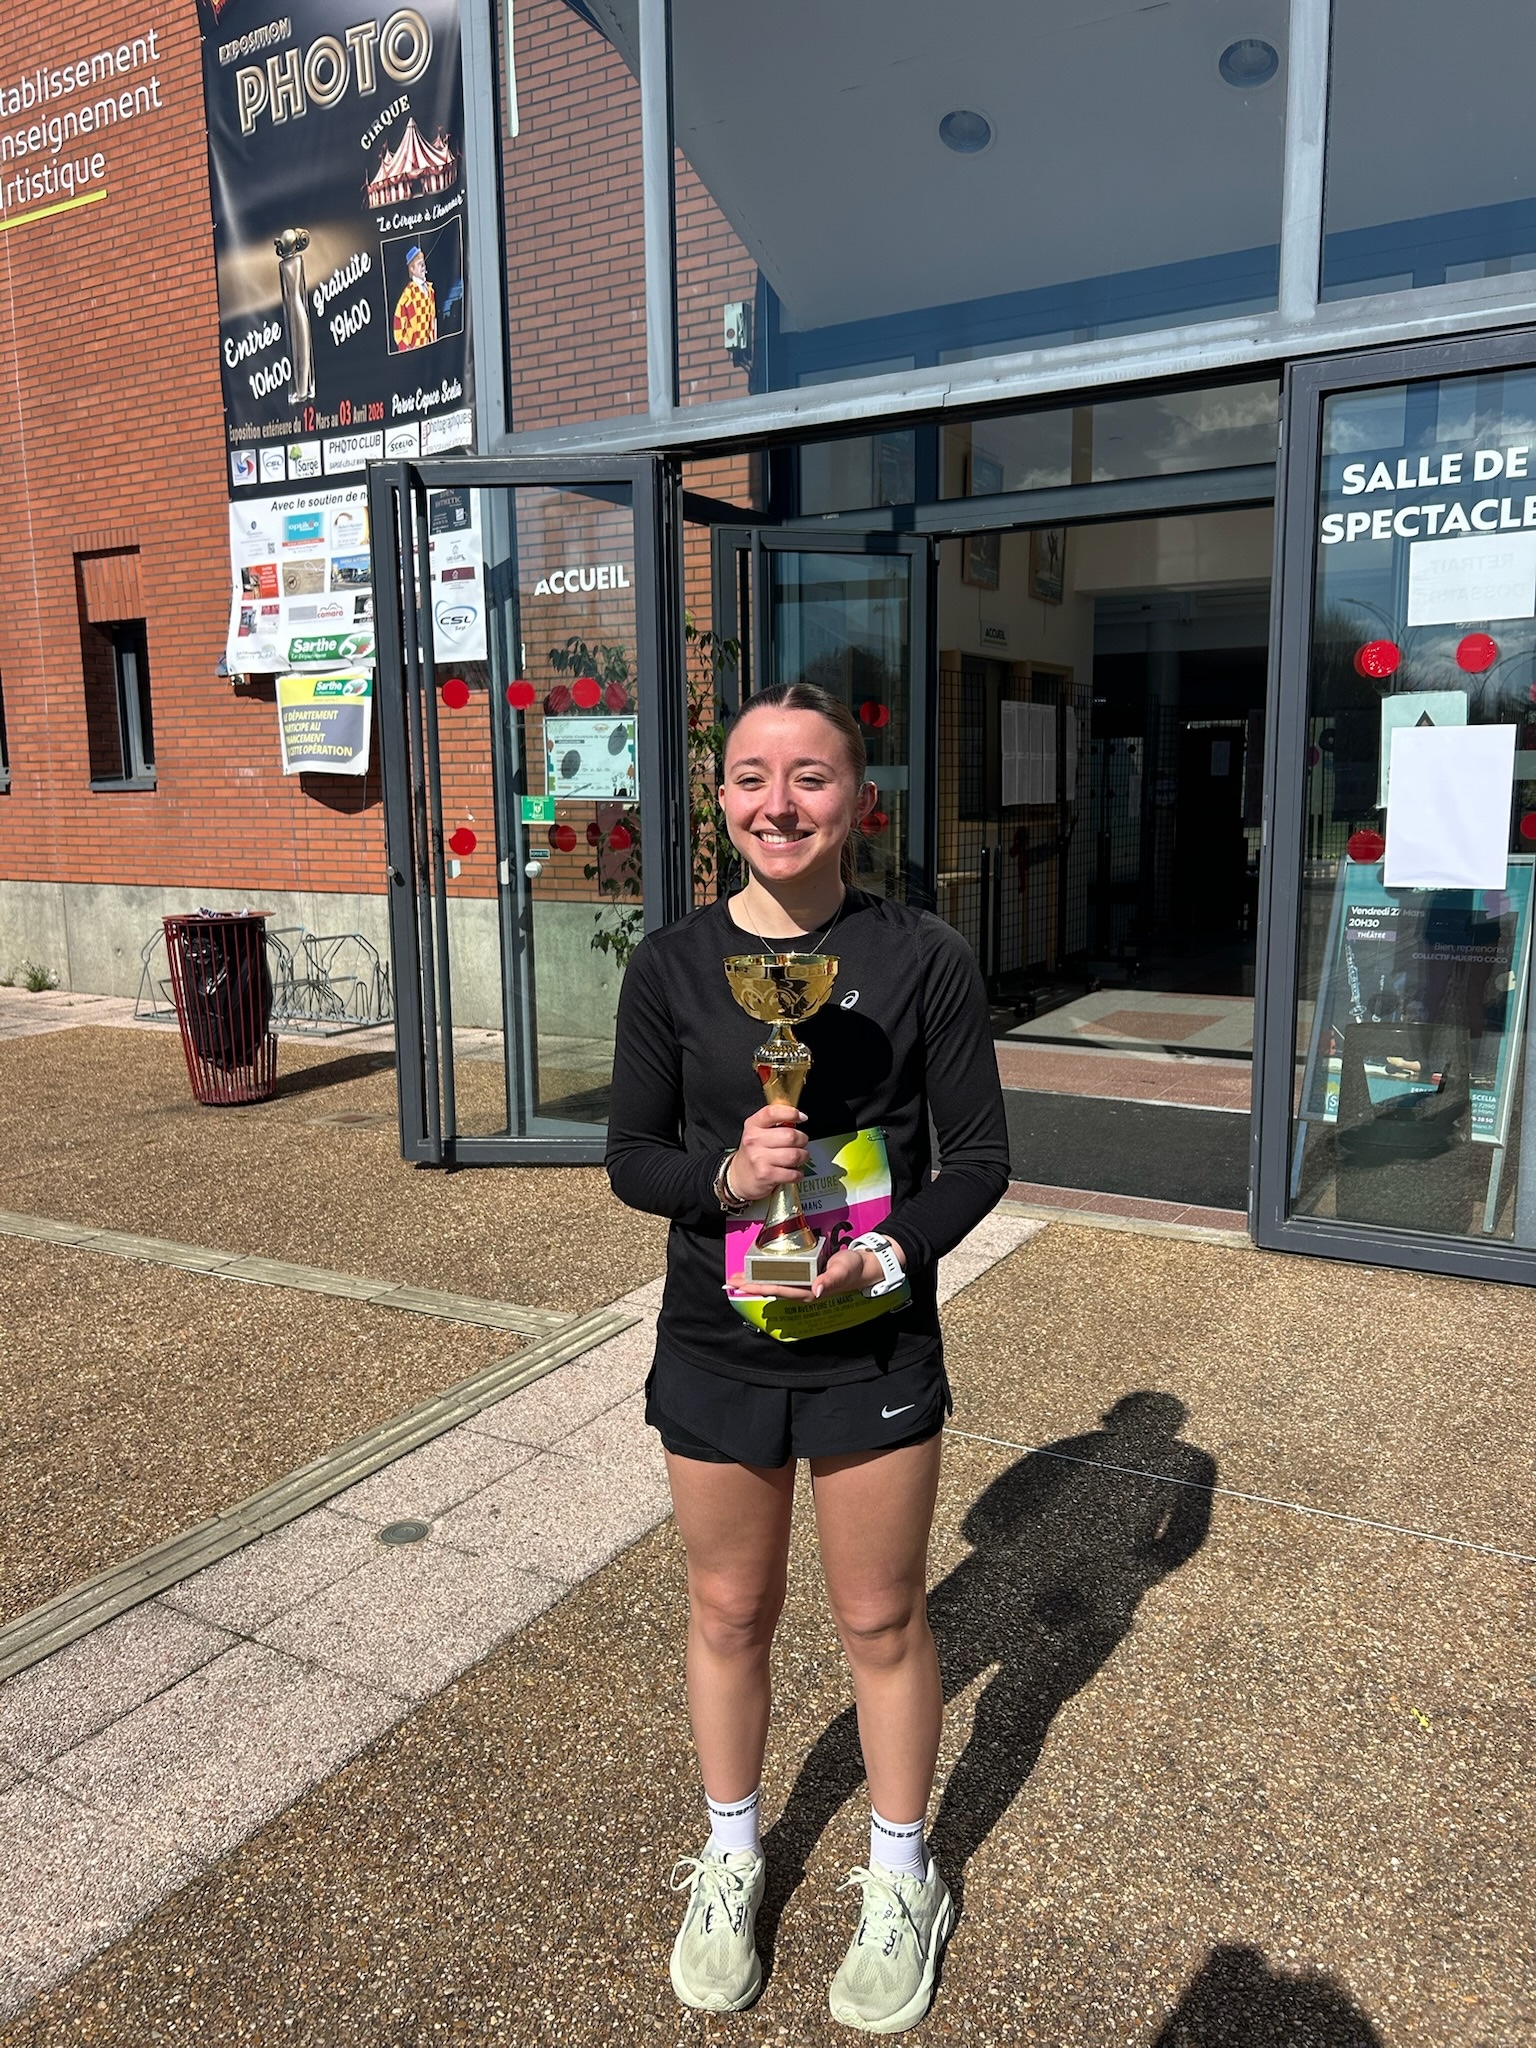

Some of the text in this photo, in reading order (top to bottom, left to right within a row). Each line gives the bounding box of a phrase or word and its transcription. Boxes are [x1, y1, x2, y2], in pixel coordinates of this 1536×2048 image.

[219, 16, 291, 65] EXPOSITION
[0, 28, 160, 117] tablissement
[236, 8, 432, 136] PHOTO
[1, 76, 162, 161] nseignement
[361, 95, 410, 150] CIRQUE
[0, 152, 105, 209] rtistique
[393, 212, 423, 230] Cirque
[224, 252, 372, 369] Entrée gratuite
[249, 299, 371, 400] 10h00 19h00
[391, 393, 414, 417] Parvis
[416, 387, 441, 415] Espace
[229, 400, 384, 445] Exposition extérieure du 12 Mars au 03 Avril 2026
[329, 434, 381, 454] PHOTO CLUB
[1342, 446, 1529, 495] SALLE DE
[271, 500, 294, 511] Avec
[297, 498, 305, 508] le
[308, 495, 343, 507] soutien
[345, 491, 357, 501] de
[1321, 494, 1536, 545] SPECTACLE
[534, 565, 630, 596] ACCUEIL
[440, 615, 471, 625] CSL
[986, 627, 1006, 641] ACCUEIL
[293, 638, 337, 653] Sarthe
[317, 681, 342, 691] Sarthe
[288, 709, 339, 722] DÉPARTEMENT
[310, 722, 321, 732] AU
[303, 743, 352, 757] OPÉRATION
[1351, 906, 1425, 918] Vendredi 27 Mars
[1349, 918, 1380, 928] 20H30
[1357, 930, 1386, 939] THÉÂTRE
[1412, 952, 1508, 964] COLLECTIF MUERTO COCO
[1434, 942, 1455, 953] Bien,
[1457, 944, 1504, 954] reprenons
[1472, 1094, 1496, 1103] SCELIA
[797, 1175, 838, 1194] VENTURE
[784, 1294, 854, 1315] RUN AVENTURE LE MANS
